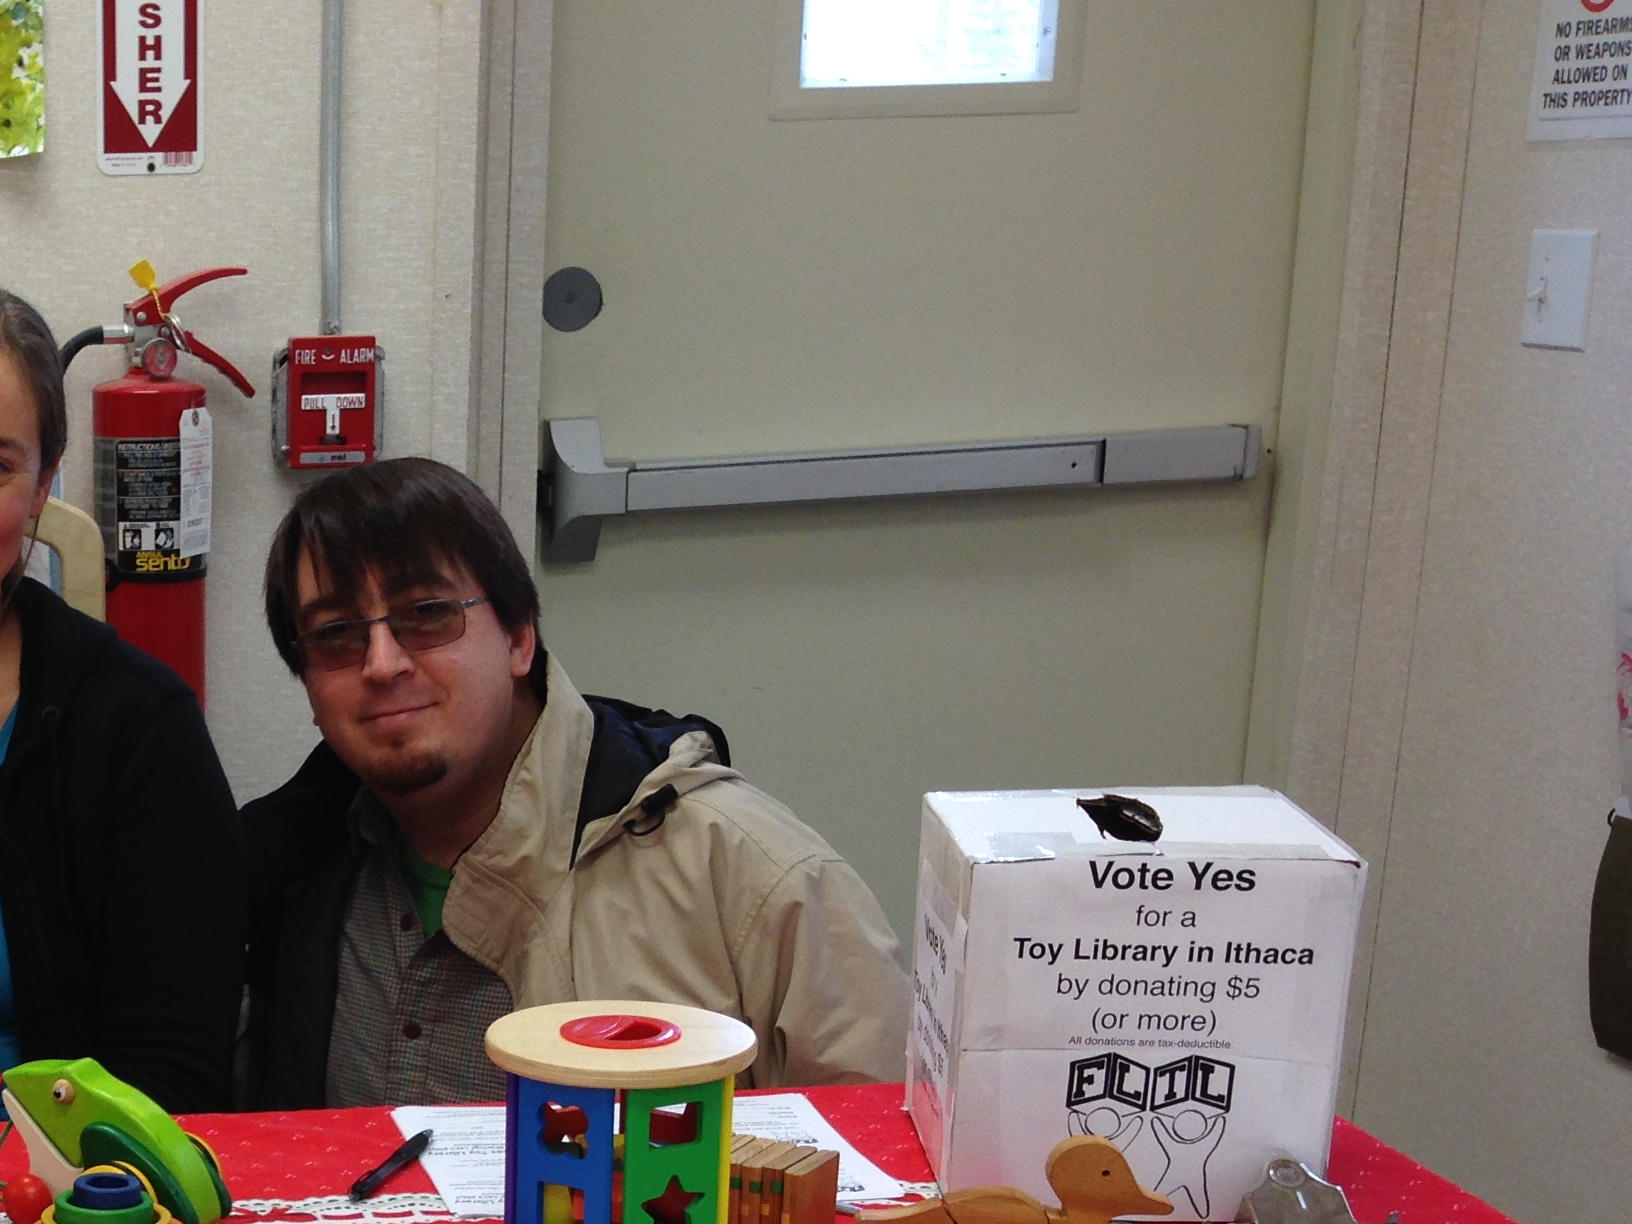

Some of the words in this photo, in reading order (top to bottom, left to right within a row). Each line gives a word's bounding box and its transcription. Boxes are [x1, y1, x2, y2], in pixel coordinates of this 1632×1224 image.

[1555, 22, 1572, 38] NO
[1554, 45, 1570, 62] OR
[1575, 40, 1632, 60] WEAPONS
[1552, 65, 1608, 85] ALLOWED
[1612, 64, 1628, 81] ON
[1542, 92, 1568, 109] THIS
[1572, 88, 1632, 107] PROPERTY
[295, 349, 317, 365] FIRE
[339, 348, 375, 363] ALARM
[303, 397, 327, 409] PULL
[336, 396, 364, 408] DOWN
[1089, 860, 1174, 891] Vote
[1187, 861, 1257, 891] Yes
[1136, 904, 1172, 927] for
[1180, 910, 1197, 928] a
[1014, 937, 1063, 965] Toy
[1074, 938, 1178, 967] Library
[1188, 940, 1214, 963] in
[1224, 941, 1315, 965] Ithaca
[1057, 973, 1089, 997] by
[1098, 974, 1216, 1002] donating
[1226, 975, 1261, 999] $5
[1092, 1007, 1129, 1034] (or
[1137, 1009, 1217, 1037] more)
[1068, 1036, 1082, 1045] All
[1084, 1036, 1135, 1047] donations
